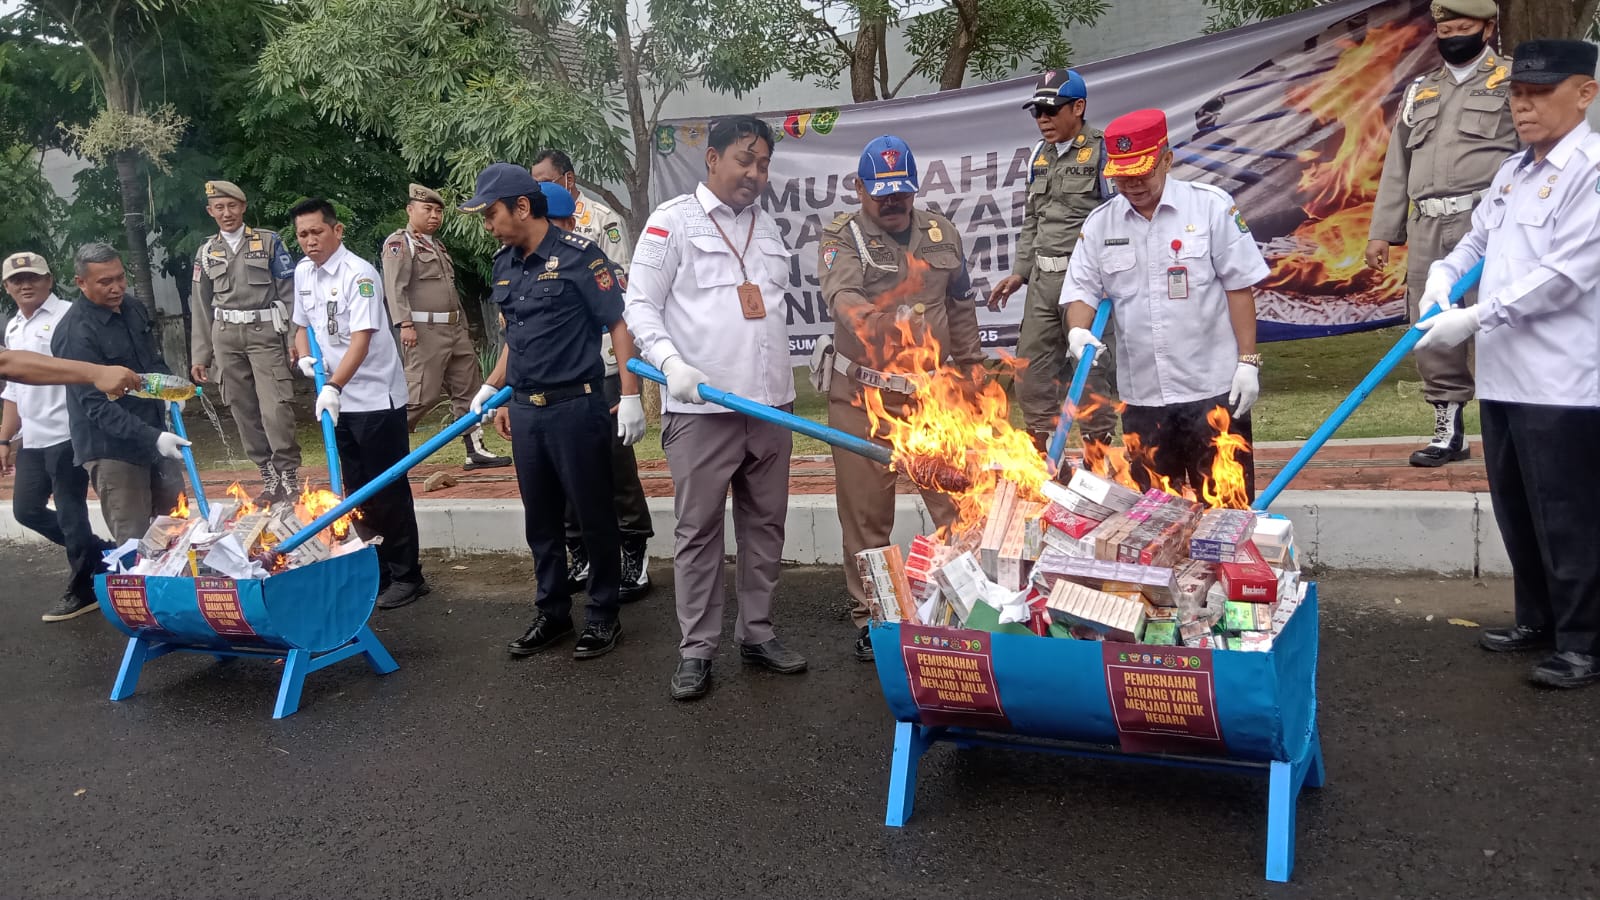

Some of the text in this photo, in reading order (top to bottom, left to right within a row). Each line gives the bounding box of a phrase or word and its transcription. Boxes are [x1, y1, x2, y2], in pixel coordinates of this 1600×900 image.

[978, 330, 998, 342] 25
[917, 653, 978, 670] PEMUSNAHAN
[919, 665, 982, 682] BARANG YANG
[1123, 672, 1197, 689] PEMUSNAHAN
[919, 676, 988, 694] MENJADI MILIK
[937, 689, 974, 703] NEGARA
[1125, 686, 1199, 703] BARANG YANG
[1124, 698, 1205, 717] MENJADI MILIK
[1144, 712, 1188, 726] NEGARA
